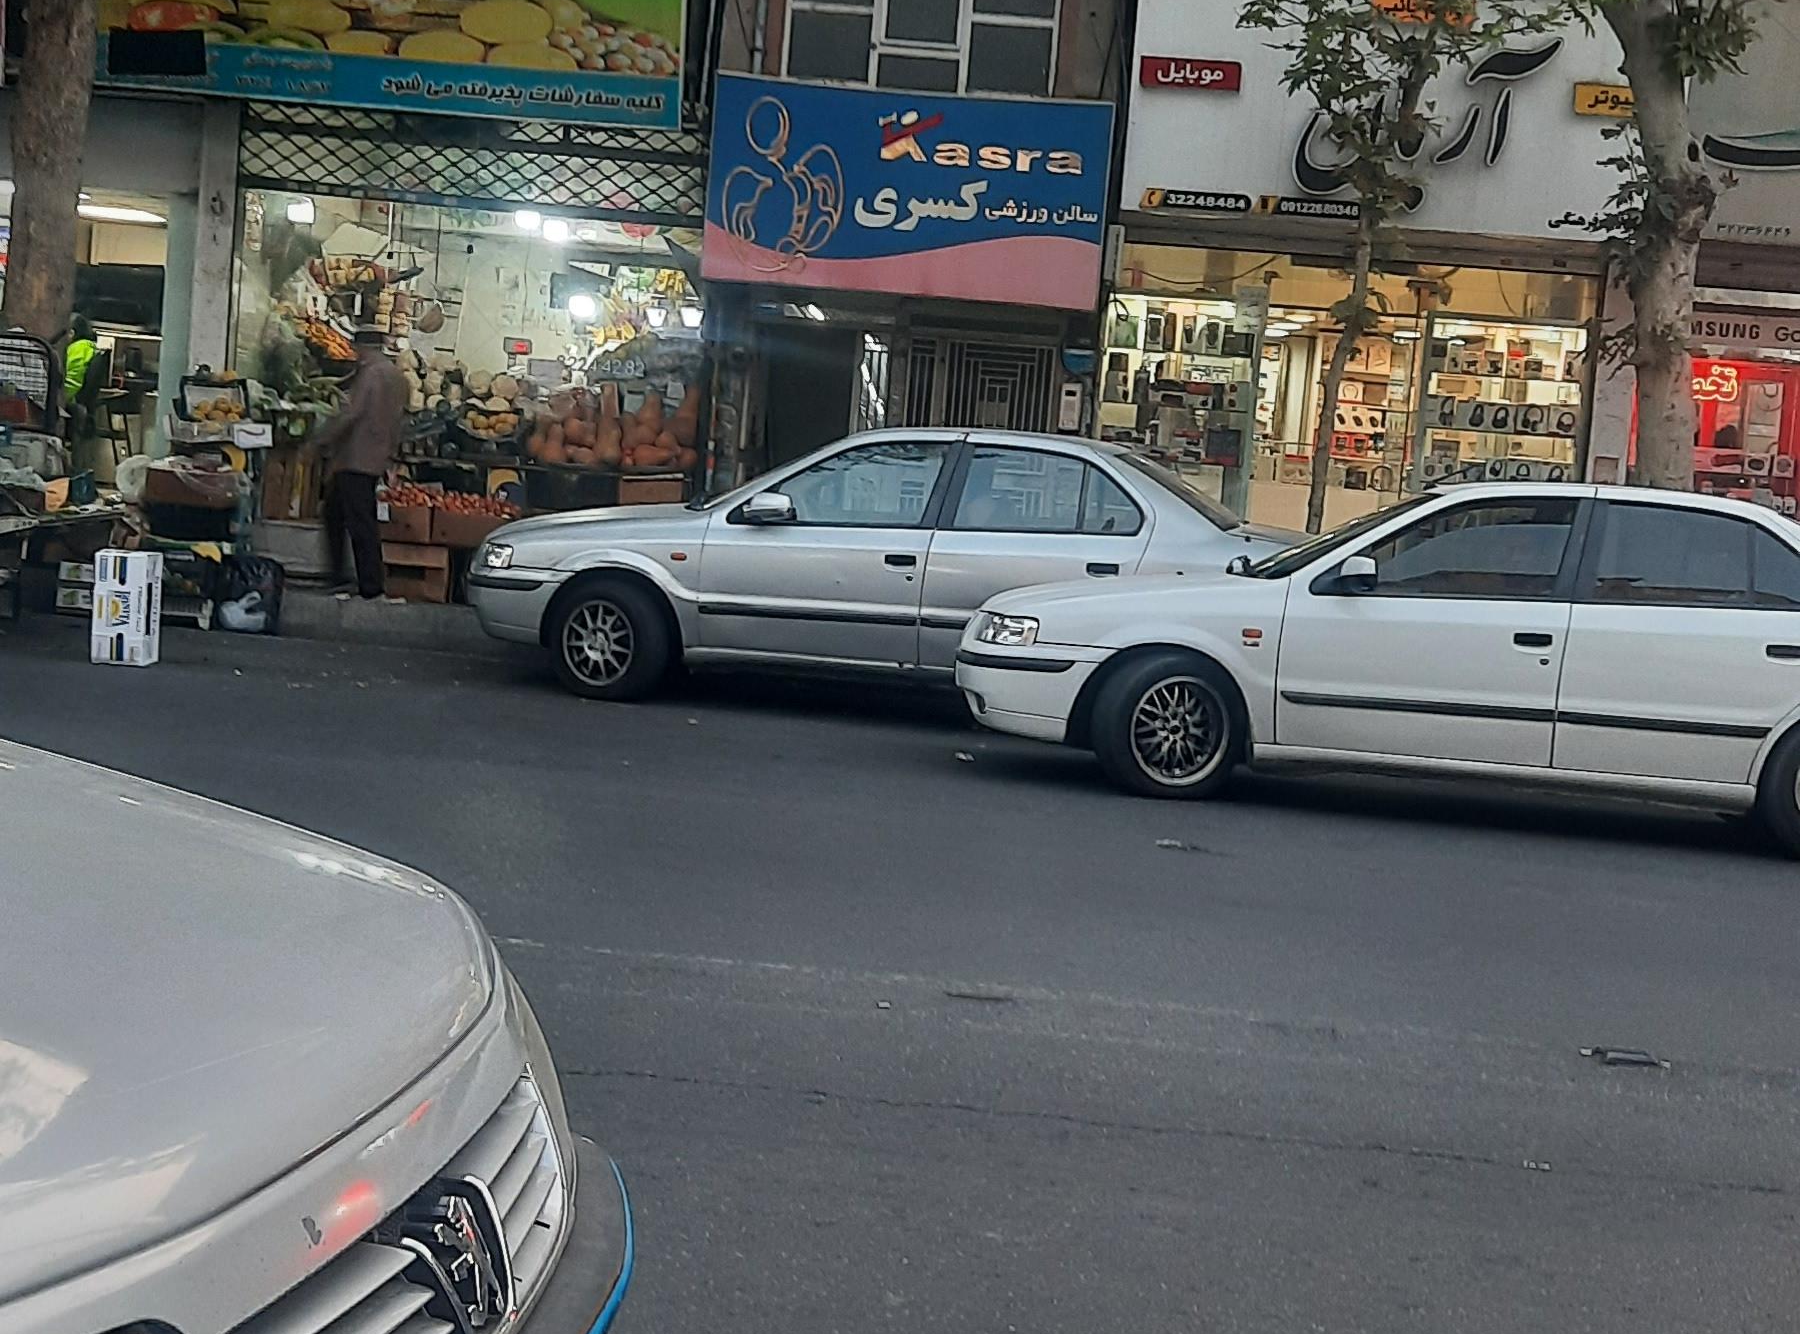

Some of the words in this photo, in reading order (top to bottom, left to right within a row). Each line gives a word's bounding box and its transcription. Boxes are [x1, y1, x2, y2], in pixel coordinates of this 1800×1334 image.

[381, 72, 421, 94] شود
[1156, 61, 1224, 85] موبایل
[424, 81, 454, 96] می
[457, 79, 523, 107] پذیرفته
[528, 85, 621, 107] سفارشات
[623, 94, 664, 111] کلیه
[1587, 90, 1635, 110] یوتر
[878, 111, 1083, 175] Kasra
[854, 179, 989, 232] کسری
[984, 198, 1049, 223] ورزشی
[1167, 193, 1247, 209] 32248484
[1053, 204, 1099, 225] سالن
[1691, 320, 1761, 340] MSUNG
